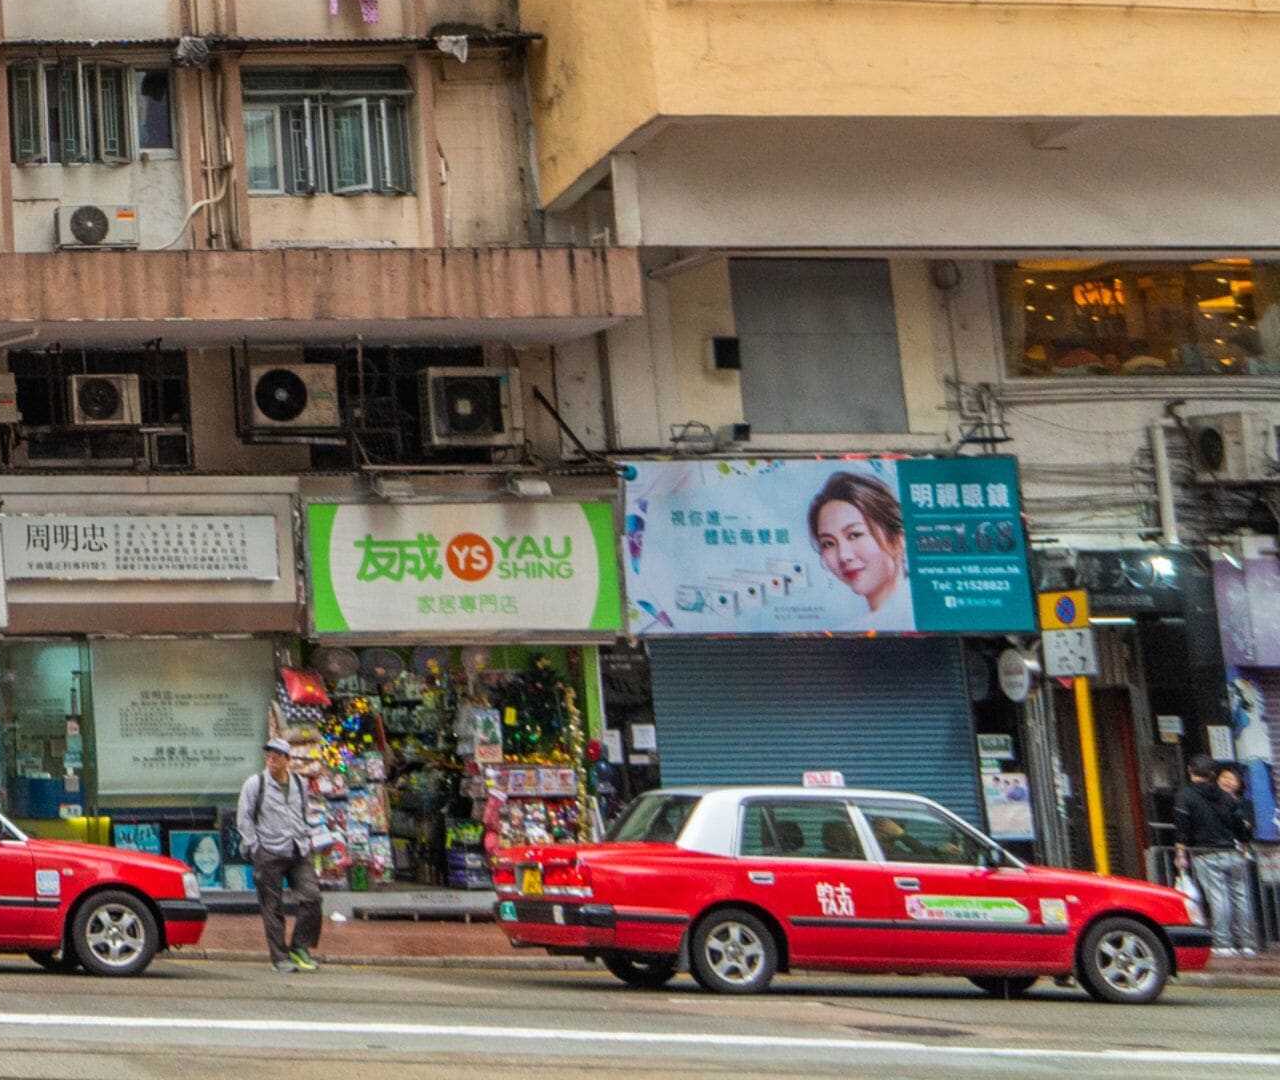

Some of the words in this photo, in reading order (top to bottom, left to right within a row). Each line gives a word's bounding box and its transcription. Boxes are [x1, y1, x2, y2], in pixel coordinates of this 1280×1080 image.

[26, 523, 109, 552] 周明忠
[491, 536, 572, 559] YAU
[451, 544, 489, 571] YS
[497, 561, 574, 580] SHING
[417, 594, 518, 615] 家居專門店
[816, 882, 852, 900] 的士
[820, 898, 856, 916] TAXI
